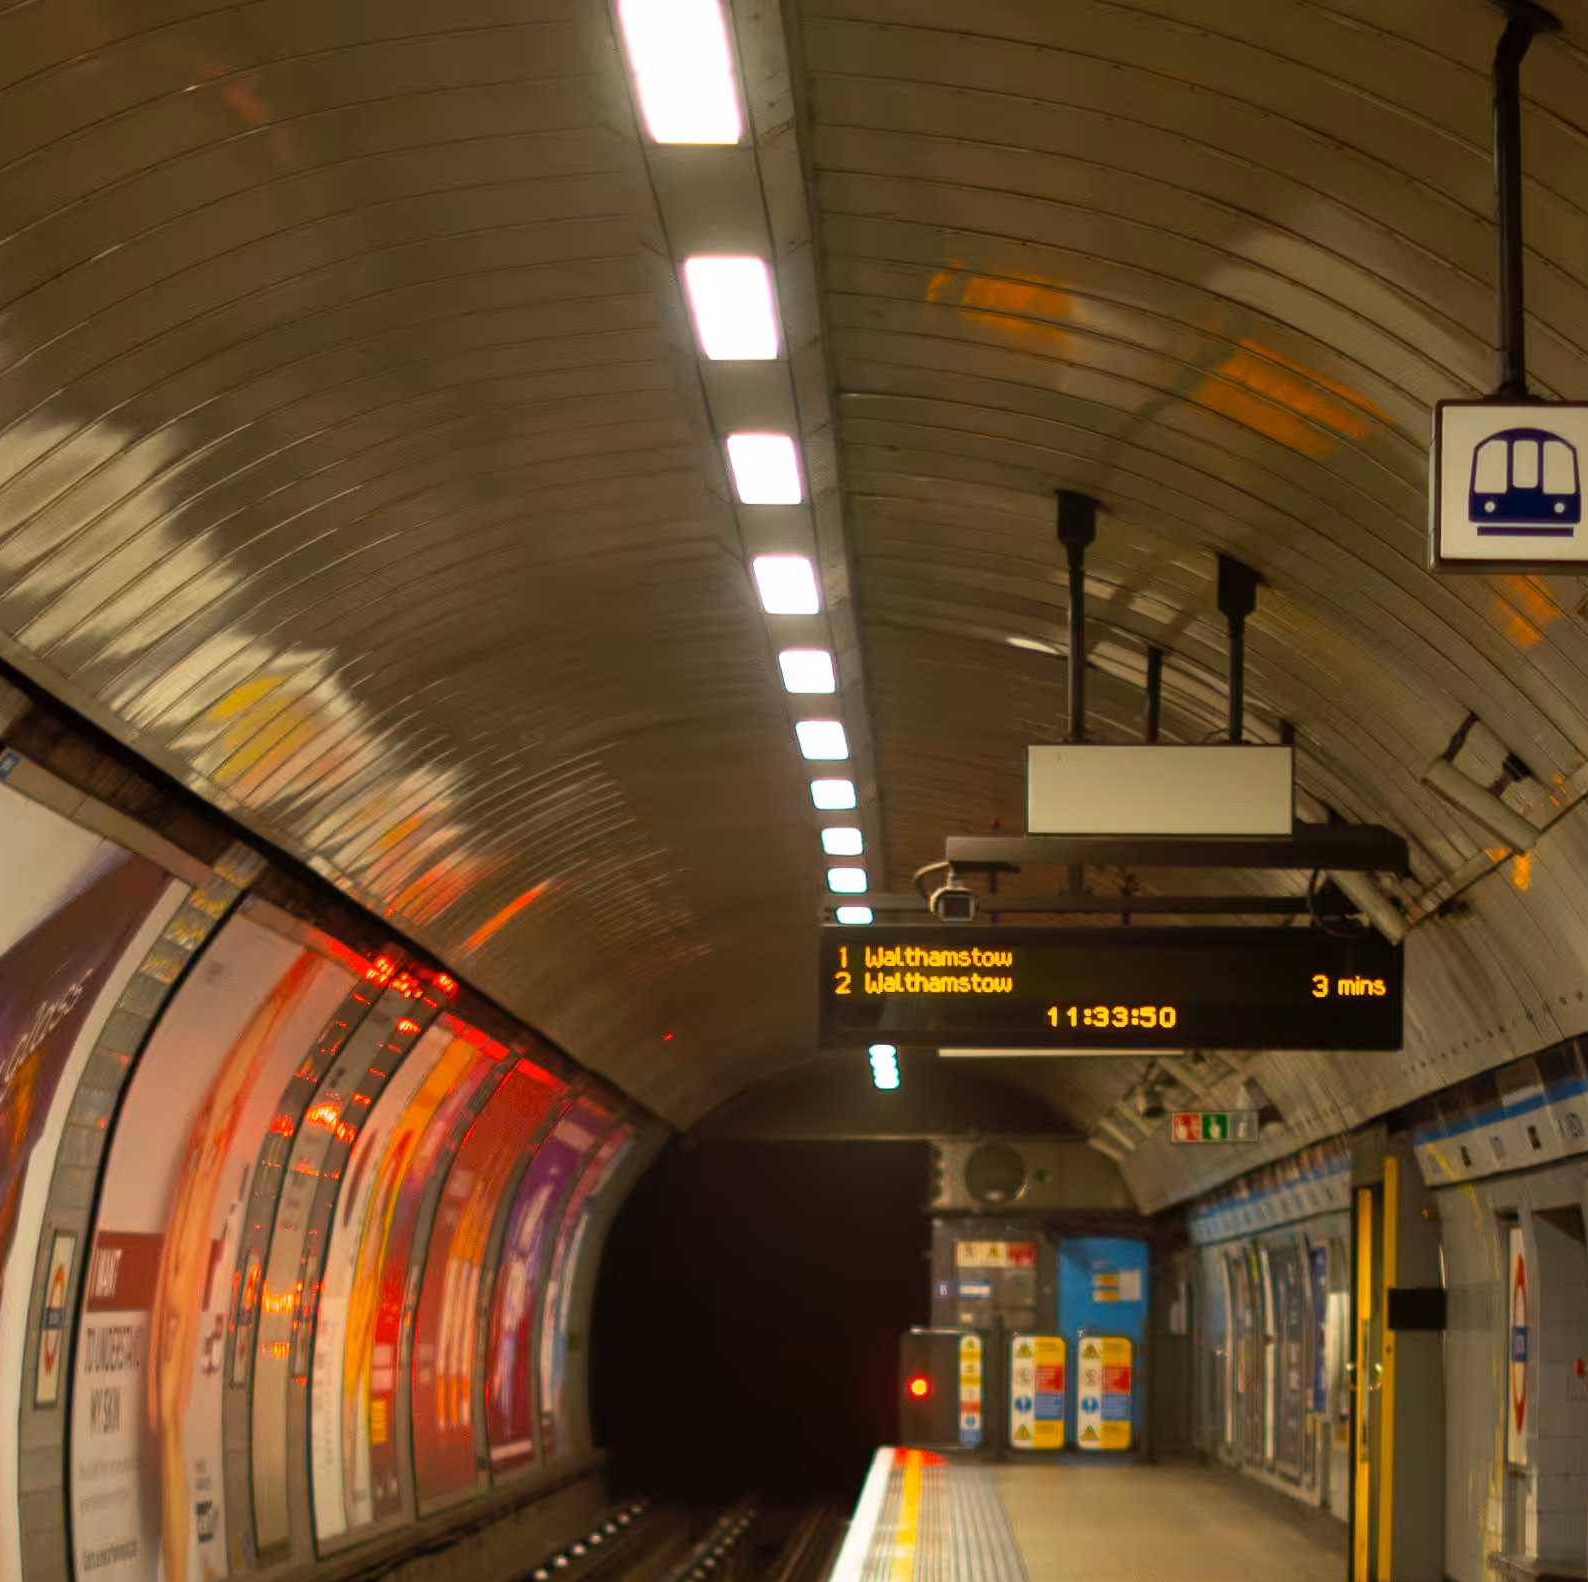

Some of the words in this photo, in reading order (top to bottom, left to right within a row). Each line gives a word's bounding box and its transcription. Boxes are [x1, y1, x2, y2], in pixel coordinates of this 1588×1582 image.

[839, 946, 847, 968] 1
[864, 946, 1012, 968] Walthamstow
[834, 972, 851, 994] 2
[864, 972, 1013, 994] Walthamstow
[1313, 974, 1329, 998] 3
[1338, 976, 1387, 997] mins
[1048, 1005, 1176, 1028] 11:33:50
